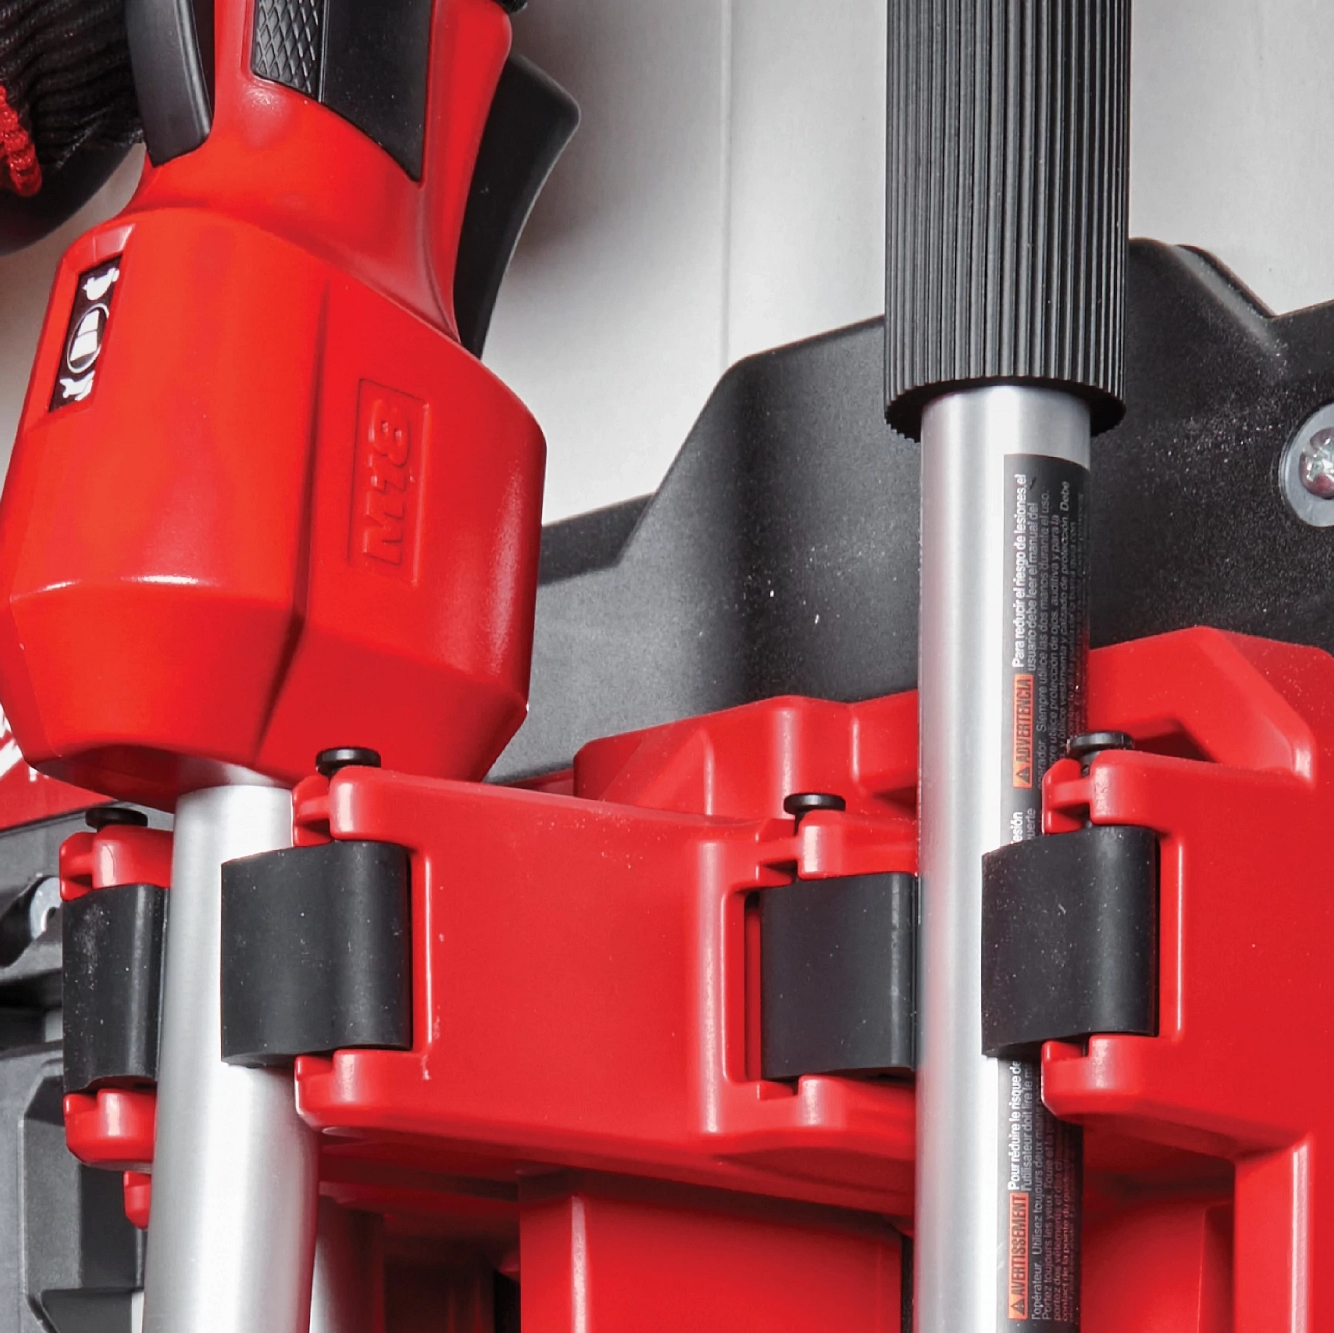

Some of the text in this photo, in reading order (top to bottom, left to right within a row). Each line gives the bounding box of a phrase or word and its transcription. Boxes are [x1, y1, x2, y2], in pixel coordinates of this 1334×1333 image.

[363, 399, 411, 567] M18
[1060, 481, 1069, 511] Debe
[1012, 474, 1027, 667] Para reducir el riesgo de el
[1027, 503, 1038, 671] usuario debe leer el manual del
[1049, 515, 1060, 710] protección de para la
[1036, 516, 1049, 732] Siempre utilice las dos manos durante el
[1016, 679, 1031, 763] ADVERTENCIA
[1007, 1076, 1024, 1190] Pour réduire le risque
[1022, 1111, 1032, 1131] doit
[1023, 1081, 1032, 1091] le
[1023, 1093, 1032, 1109] lire
[1021, 1133, 1032, 1191] l'utilisateur
[1032, 1141, 1044, 1254] Utilisez toujours deux
[1011, 1195, 1026, 1296] AVERTISSEMENT
[1042, 1223, 1053, 1319] Portez toujours les
[1053, 1266, 1061, 1321] portez des
